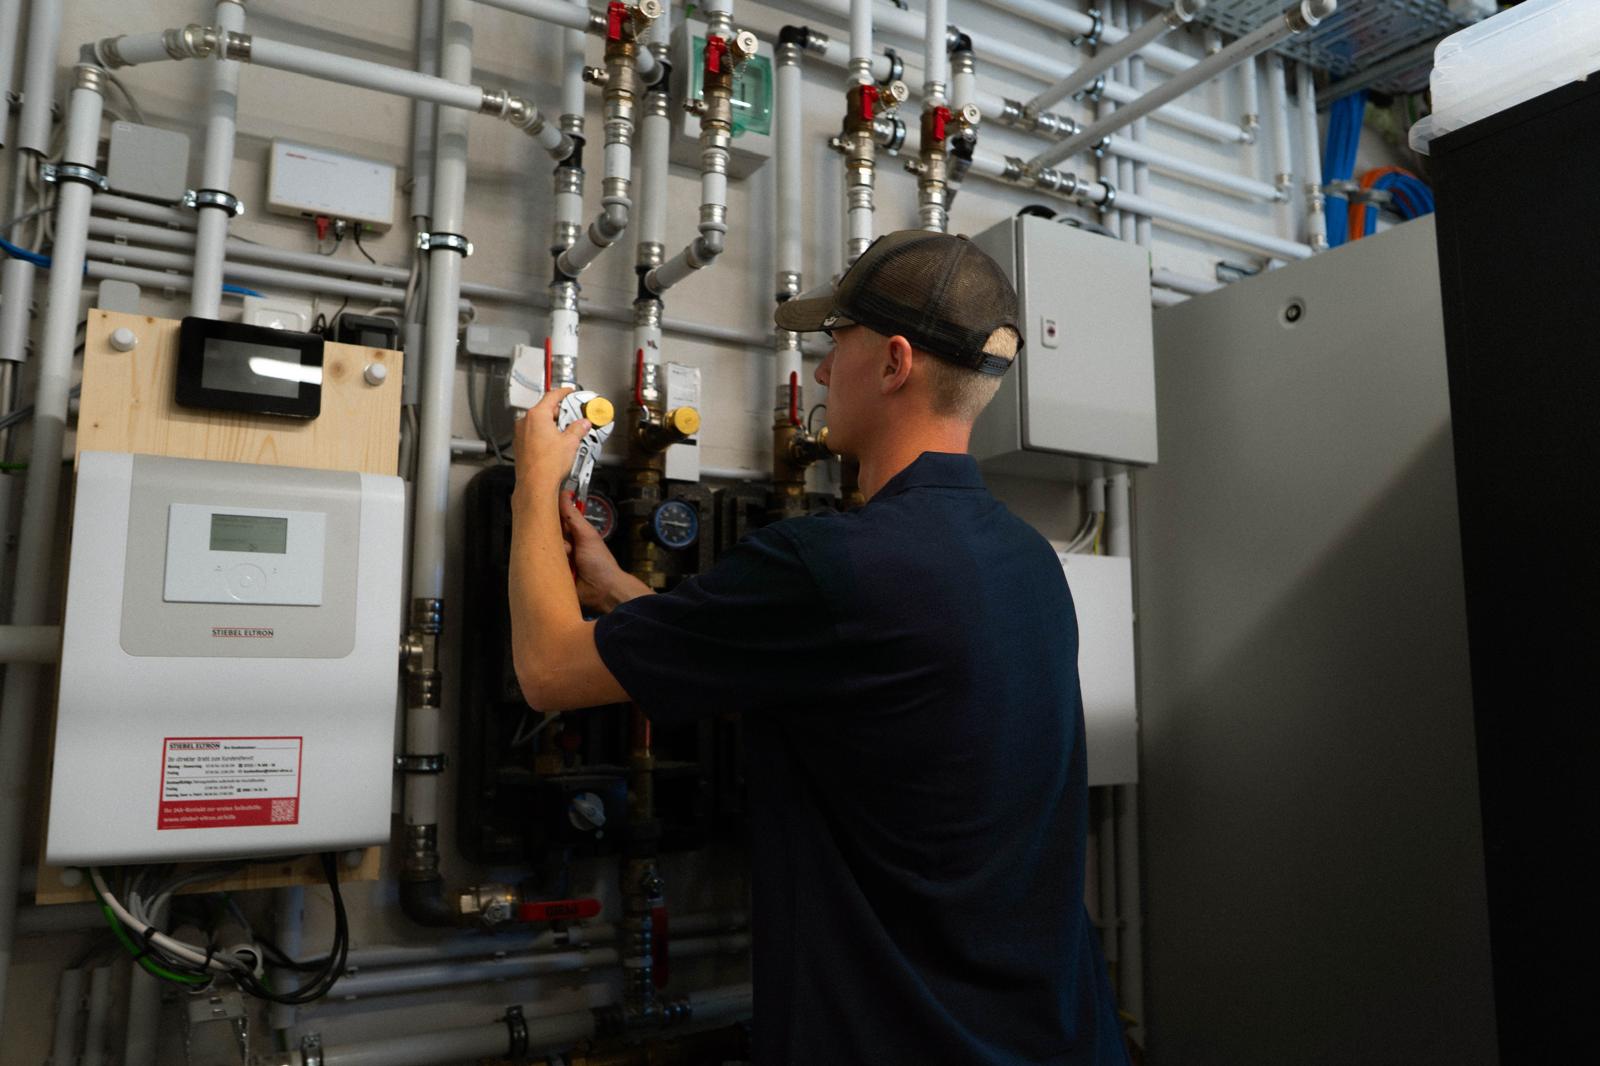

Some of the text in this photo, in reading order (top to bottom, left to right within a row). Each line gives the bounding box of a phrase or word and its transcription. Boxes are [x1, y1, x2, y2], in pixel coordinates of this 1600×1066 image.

[212, 628, 274, 638] STIEBEL ELTRON
[169, 742, 194, 750] STIEBEL
